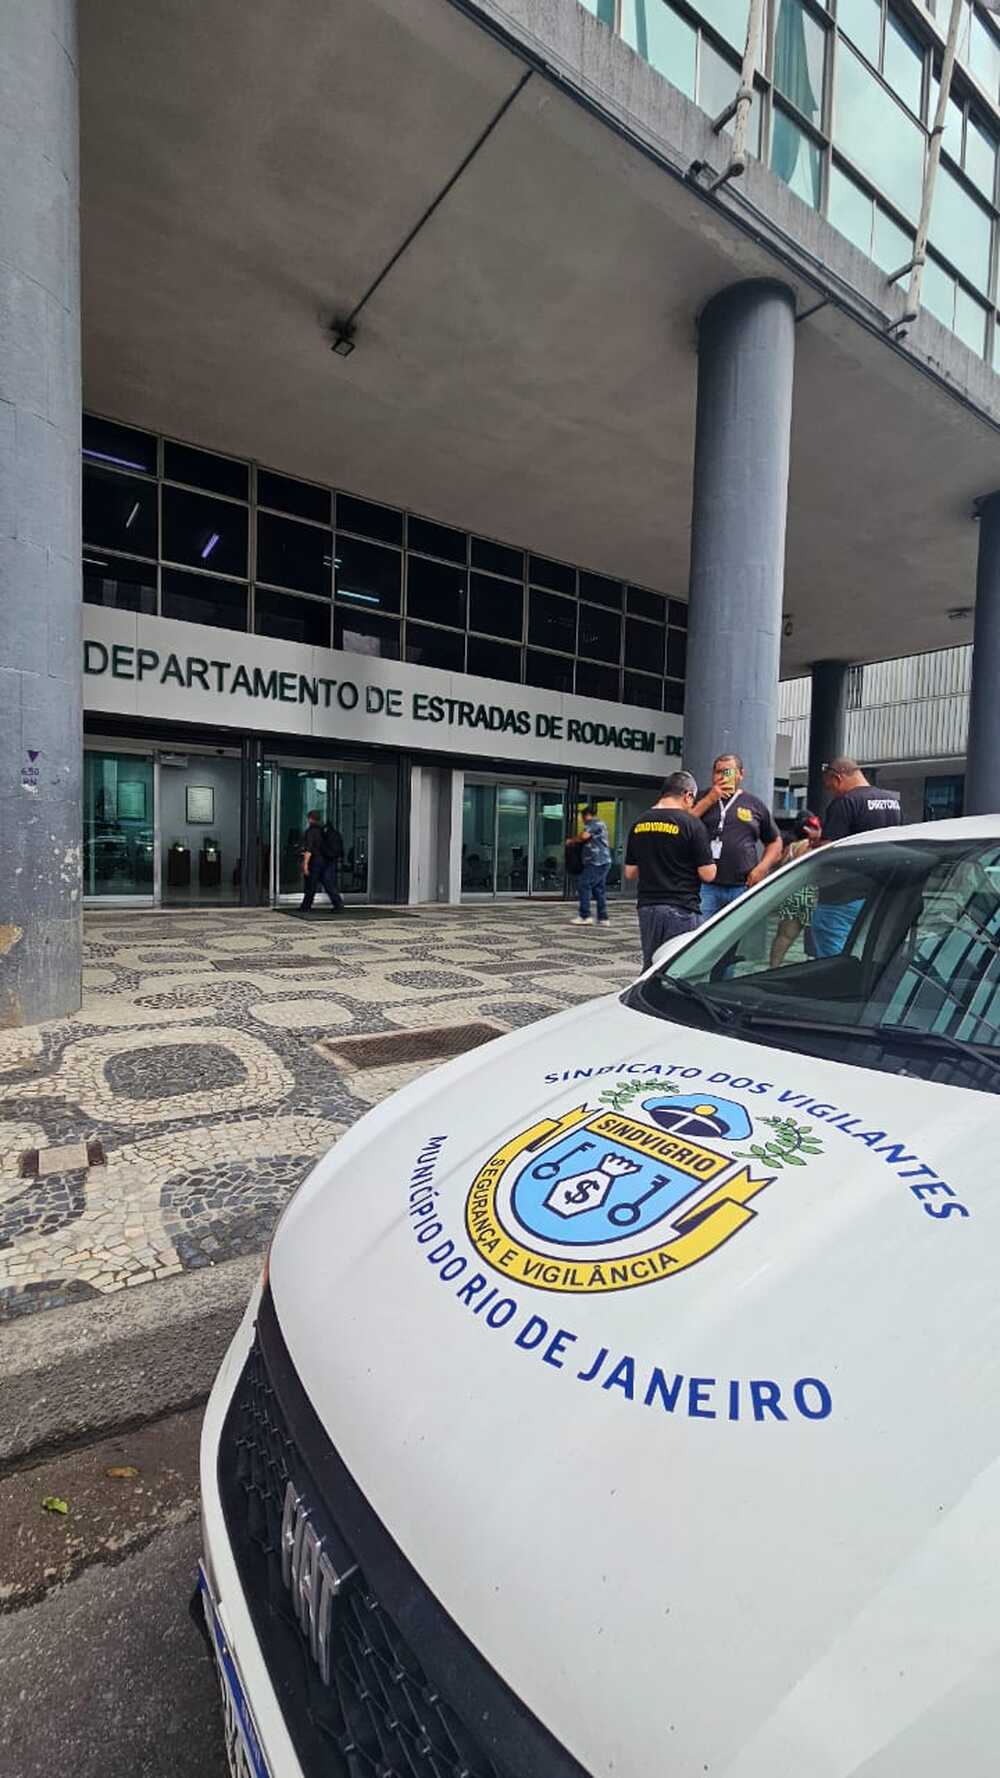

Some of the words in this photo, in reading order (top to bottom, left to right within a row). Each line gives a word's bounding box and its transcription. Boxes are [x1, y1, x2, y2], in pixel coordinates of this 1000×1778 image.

[83, 640, 359, 710] DEPARTAMENTO
[366, 685, 403, 717] DE
[412, 693, 531, 735] ESTRADAS
[536, 714, 563, 739] DE
[567, 718, 656, 753] RODAGEM
[544, 1063, 702, 1084] SINDICATO
[707, 1072, 774, 1094] DOS
[777, 1090, 970, 1219] VIGILANTES
[597, 1118, 717, 1172] SINDVIGRIO
[409, 1135, 449, 1244] MUNICÍPIO
[471, 1159, 505, 1253] SEGURANÇA
[498, 1248, 518, 1267] E
[522, 1251, 679, 1287] VIGILÂNCIA
[427, 1239, 468, 1281] DO
[456, 1272, 518, 1329] RIO
[514, 1314, 578, 1369] DE
[576, 1347, 833, 1422] JANEIRO
